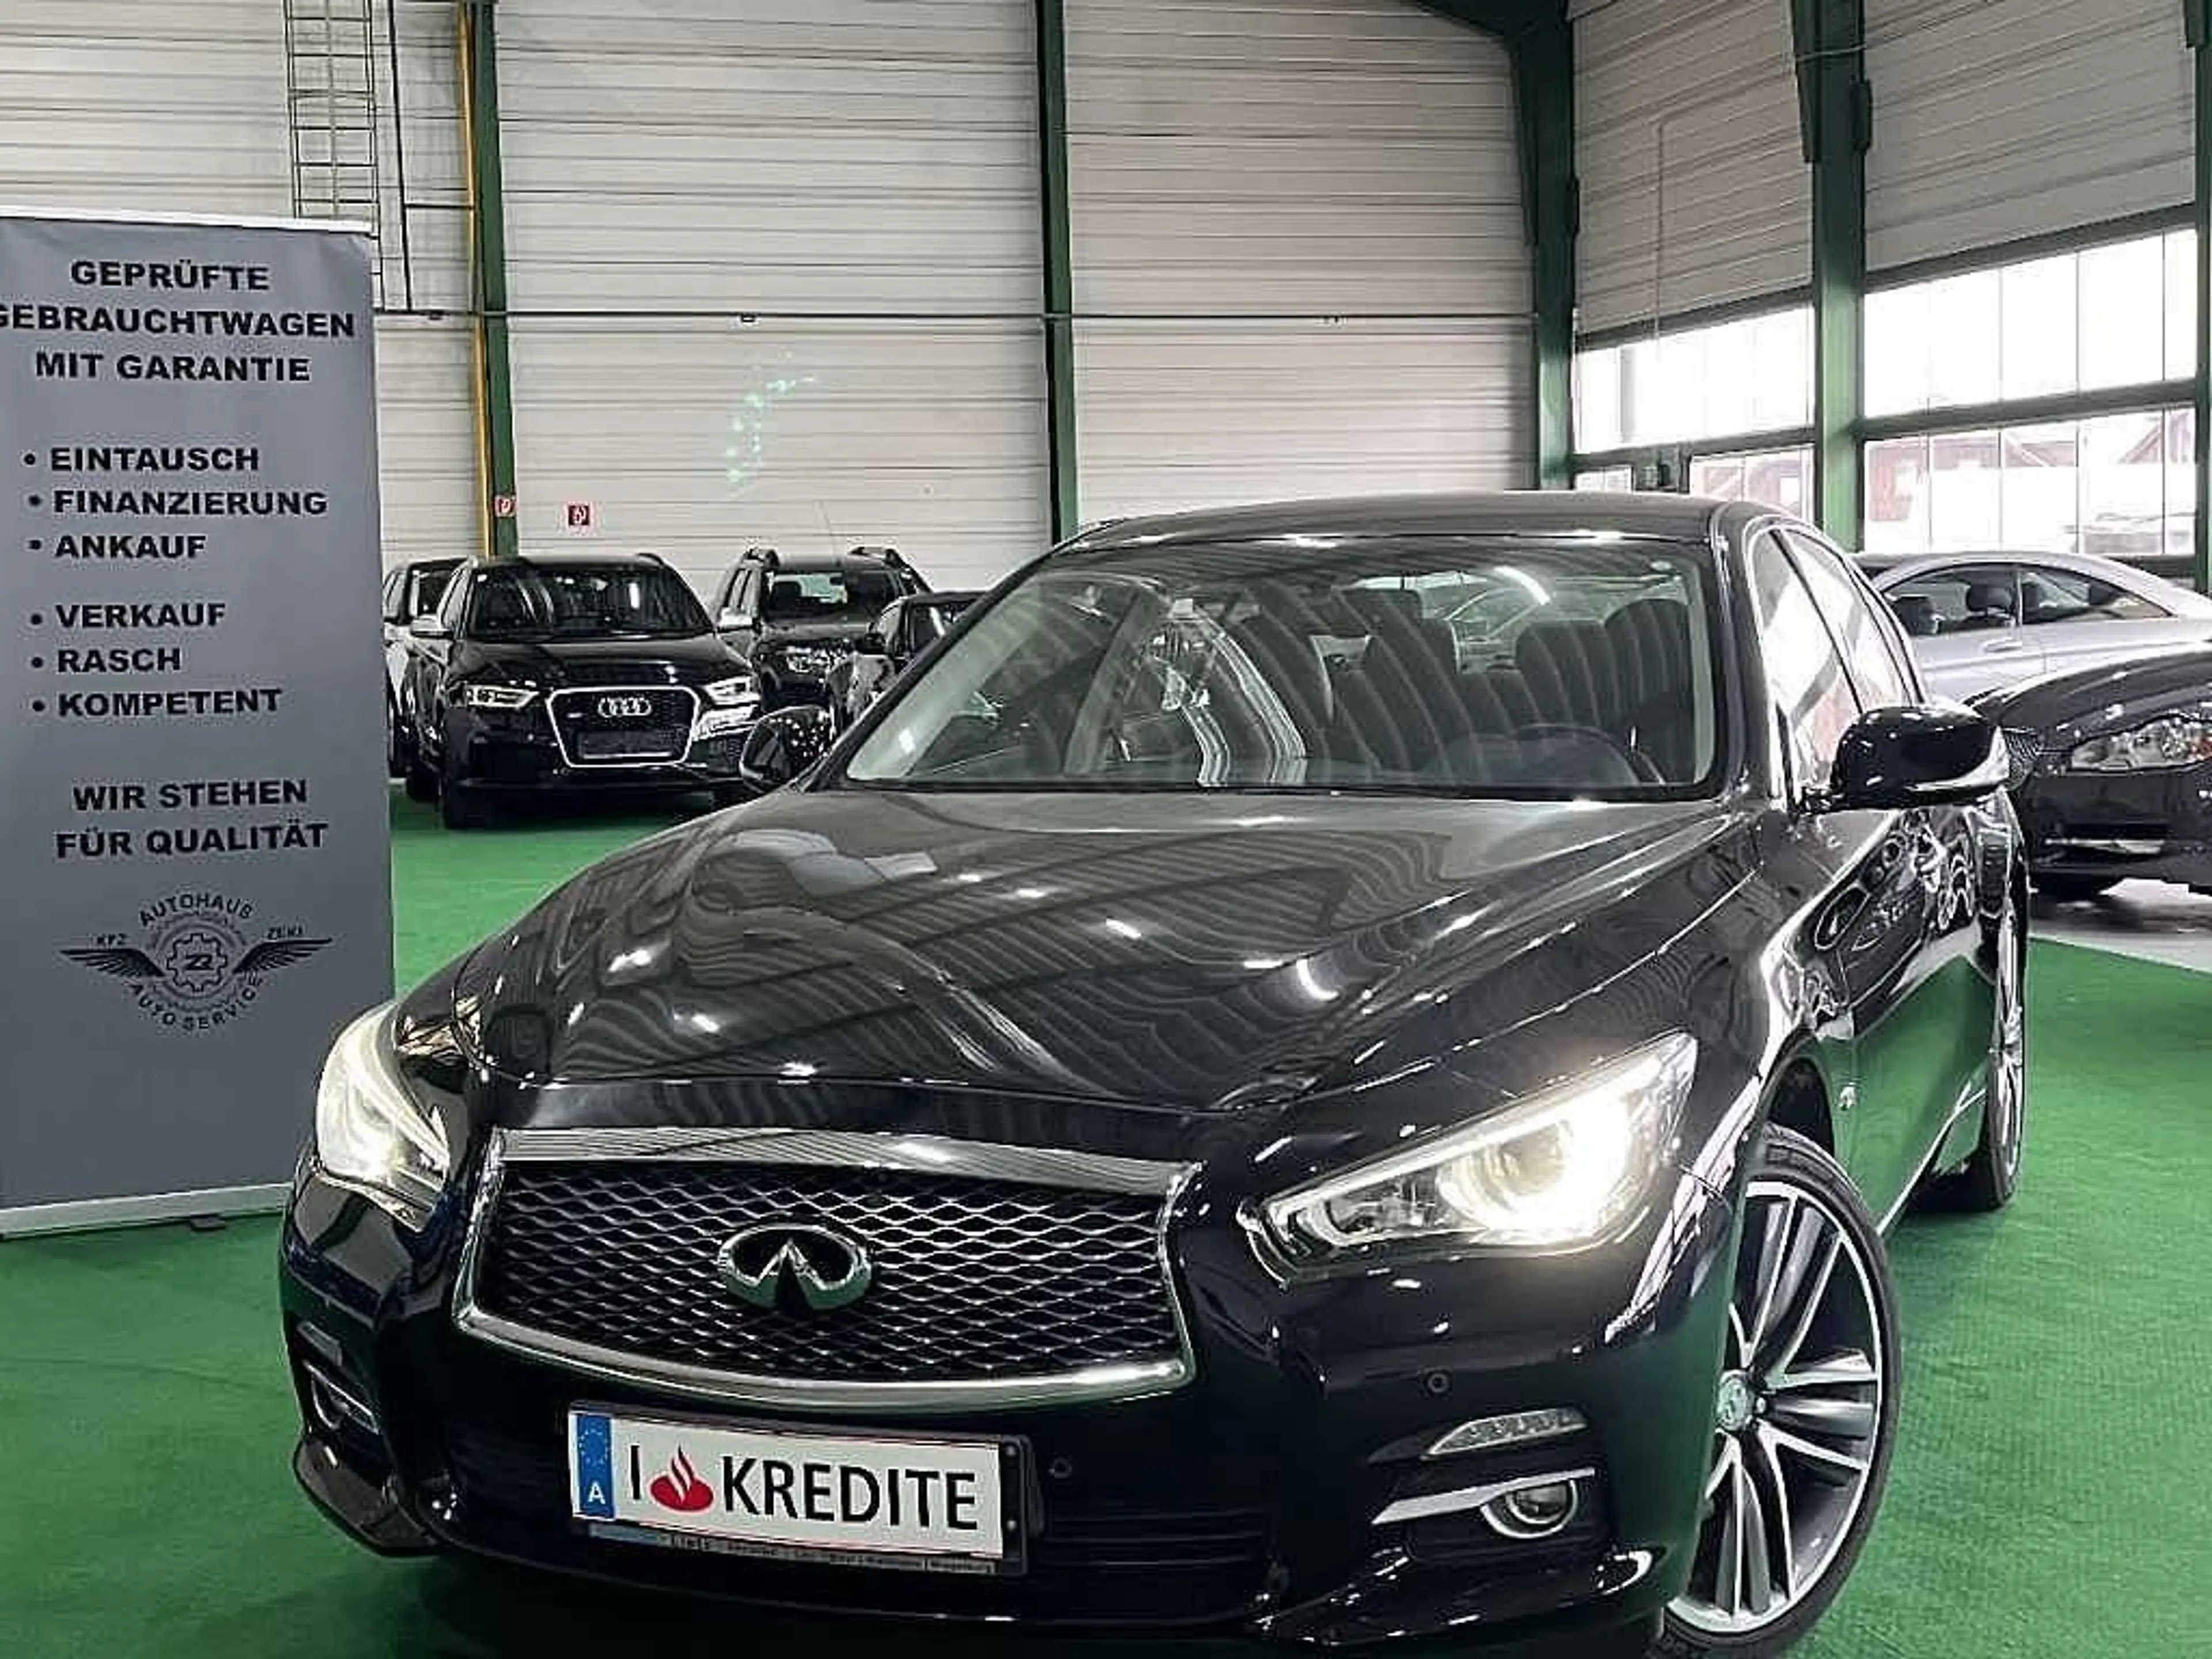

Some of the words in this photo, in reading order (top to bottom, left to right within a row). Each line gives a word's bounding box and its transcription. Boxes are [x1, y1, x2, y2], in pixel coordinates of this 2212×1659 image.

[71, 259, 270, 290] GEPRÜFTE
[36, 351, 104, 378] MIT
[116, 354, 310, 381] GARANTIE
[50, 447, 259, 472] EINTAUSCH
[54, 490, 327, 516] FINANZIERUNG
[55, 535, 206, 559] ANKAUF
[56, 603, 226, 628] VERKAUF
[58, 647, 180, 673] RASCH
[59, 688, 282, 717] KOMPETENT
[73, 785, 147, 811] WIR
[158, 779, 307, 808] STEHEN
[56, 826, 133, 859] FÜR
[146, 818, 328, 856] QUALITÄT
[588, 1480, 606, 1505] A
[722, 1455, 978, 1530] KREDITE
